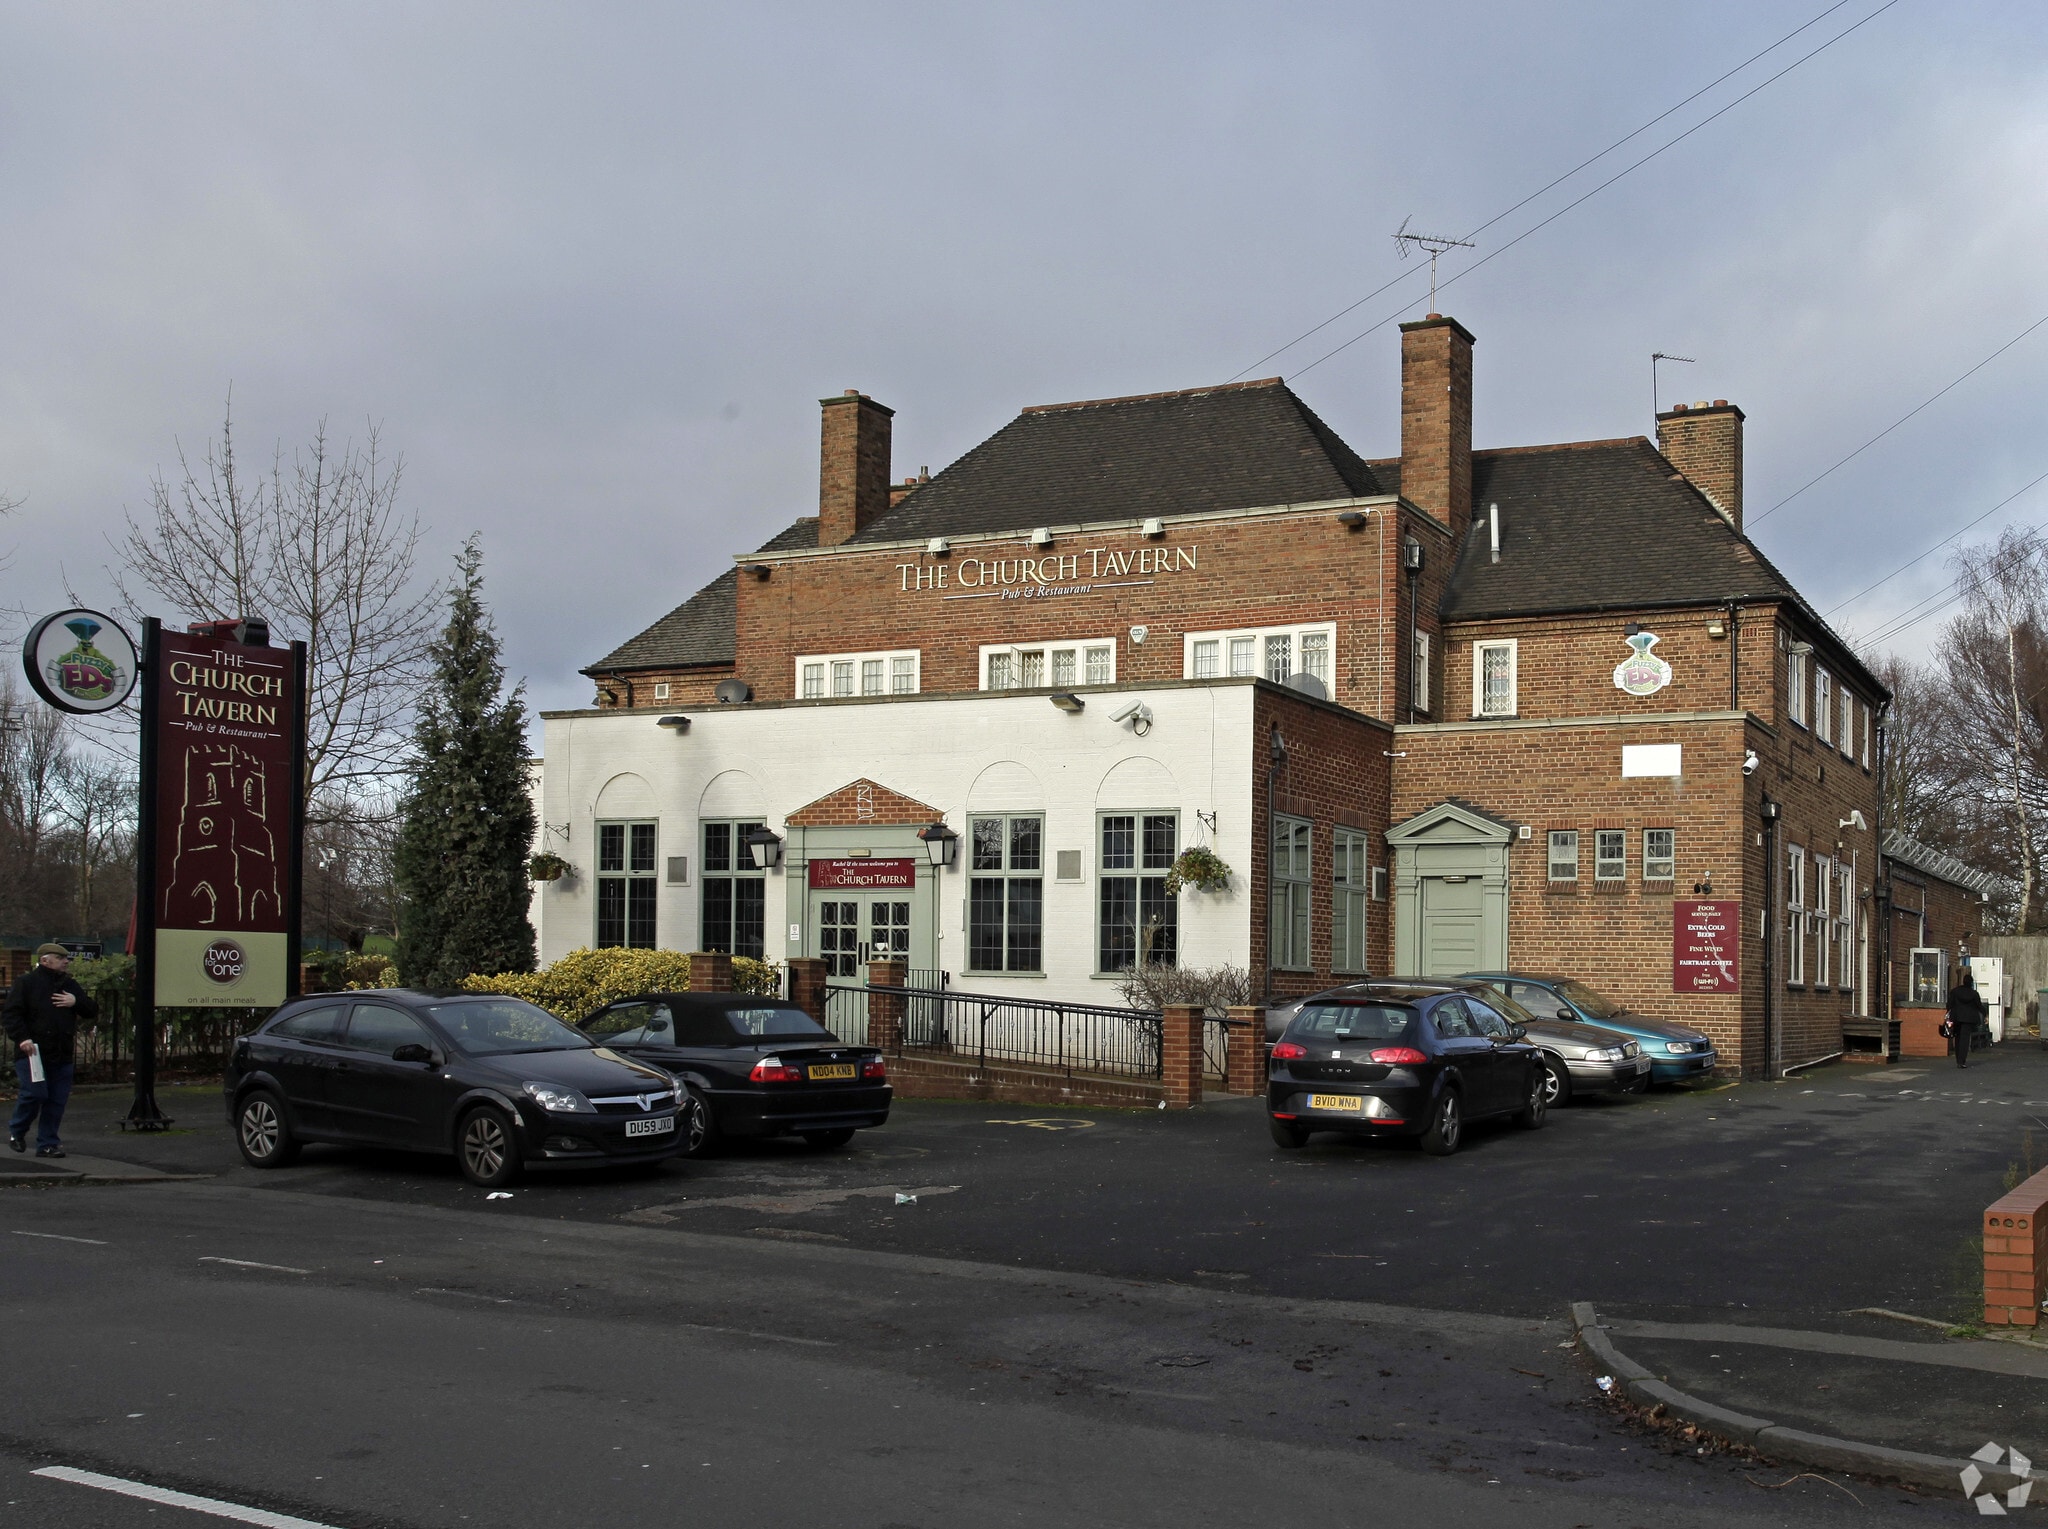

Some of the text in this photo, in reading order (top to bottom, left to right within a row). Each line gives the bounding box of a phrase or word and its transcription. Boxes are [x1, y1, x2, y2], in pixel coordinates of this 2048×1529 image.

[895, 545, 1199, 591] THE CHURCH TAVERN
[1001, 584, 1092, 600] Pub & Restaurant
[211, 649, 244, 668] THE
[169, 661, 283, 698] CHURCH
[175, 690, 277, 726] TAVERN
[185, 721, 268, 739] Pub & Restaurant
[837, 874, 907, 885] CHURCH TAVERN
[208, 947, 240, 961] two
[204, 957, 216, 967] for
[212, 964, 241, 976] one
[200, 996, 210, 1004] all
[211, 996, 232, 1004] main
[233, 996, 256, 1004] meals
[812, 1066, 835, 1077] ND04
[1338, 1097, 1357, 1108] WNA
[629, 1118, 672, 1134] DU59 JXO
